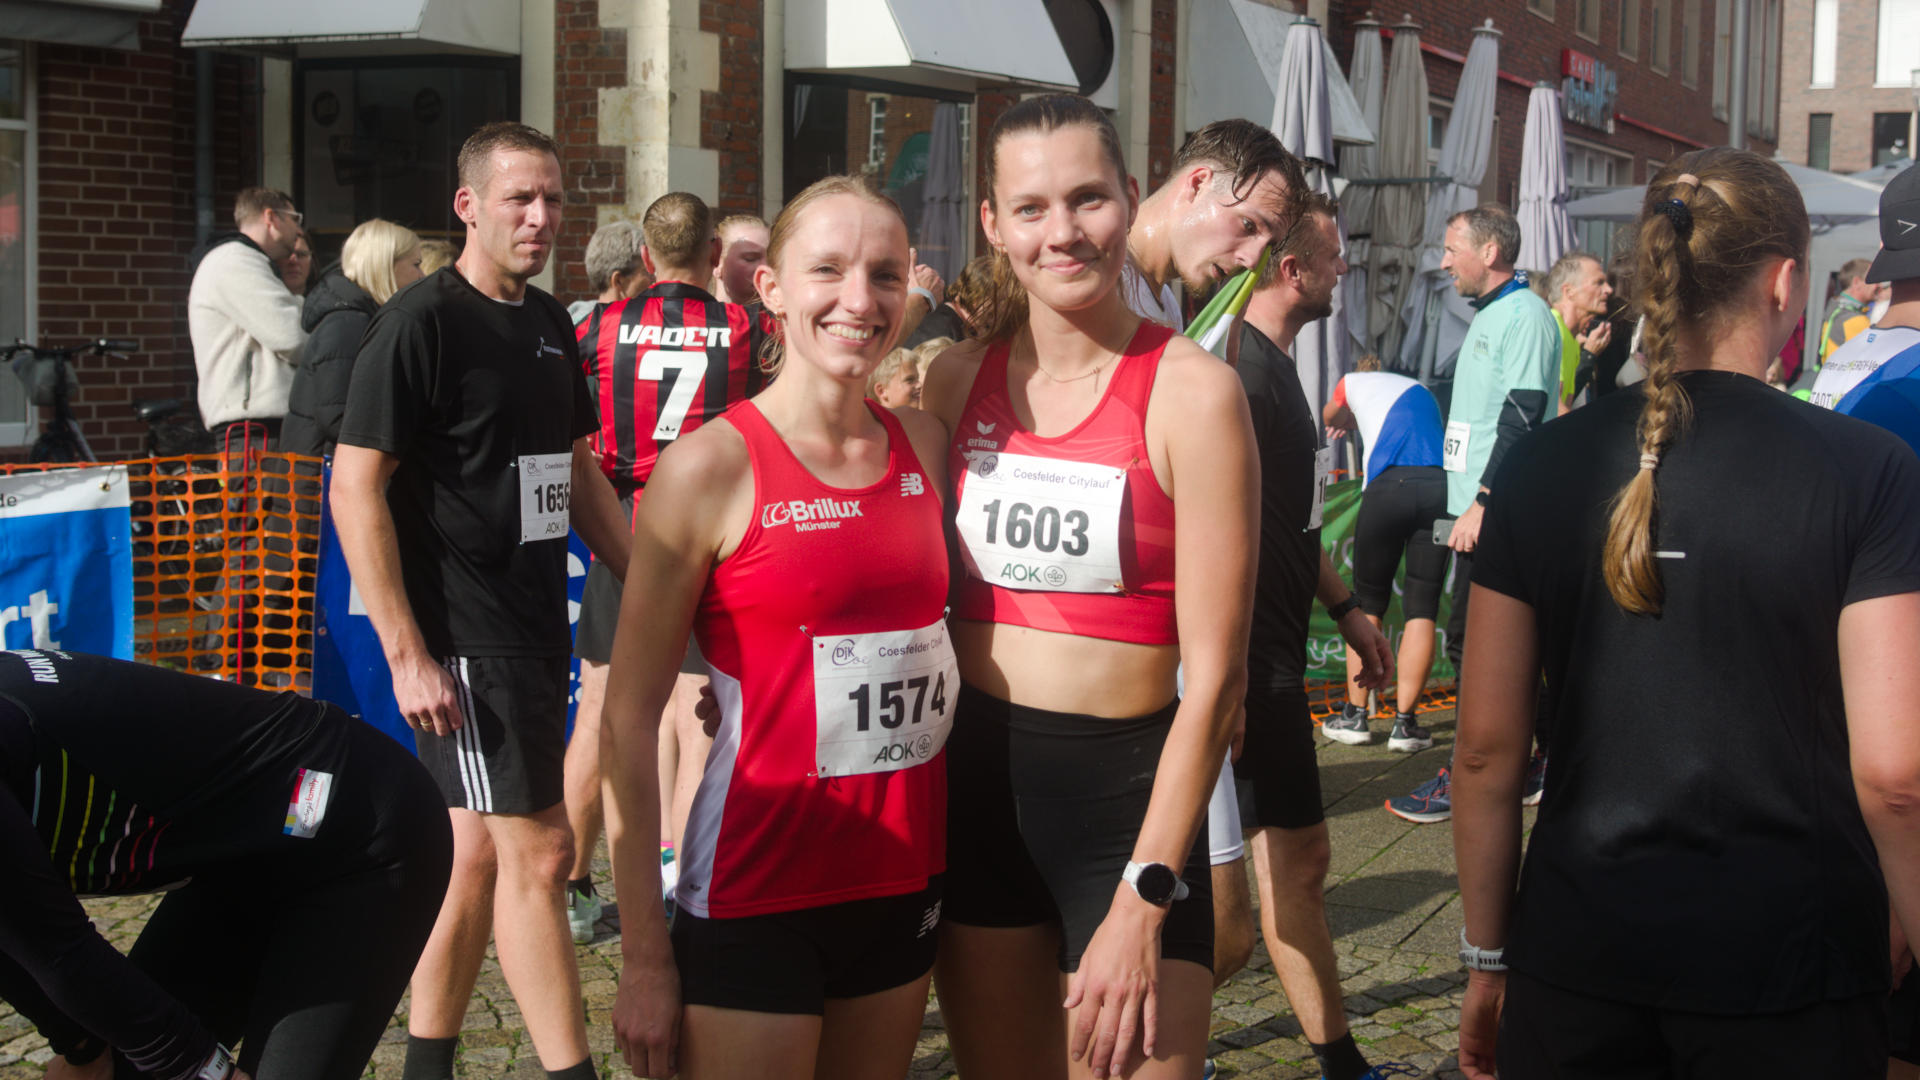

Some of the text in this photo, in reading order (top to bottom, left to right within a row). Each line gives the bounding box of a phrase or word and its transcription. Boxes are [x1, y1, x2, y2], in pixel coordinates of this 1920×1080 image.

[619, 324, 732, 348] VADER
[637, 349, 709, 441] 7
[967, 437, 998, 450] erima
[1013, 467, 1067, 485] Coesfelder
[1068, 474, 1111, 490] Citylauf
[788, 498, 864, 522] Brillux
[545, 522, 561, 534] AOK
[795, 520, 841, 533] Münster
[982, 499, 1090, 557] 1603
[1001, 563, 1042, 583] AOK
[878, 640, 930, 658] Coesfelder
[25, 657, 60, 684] RUN
[848, 670, 946, 732] 1574
[873, 740, 915, 765] AOK
